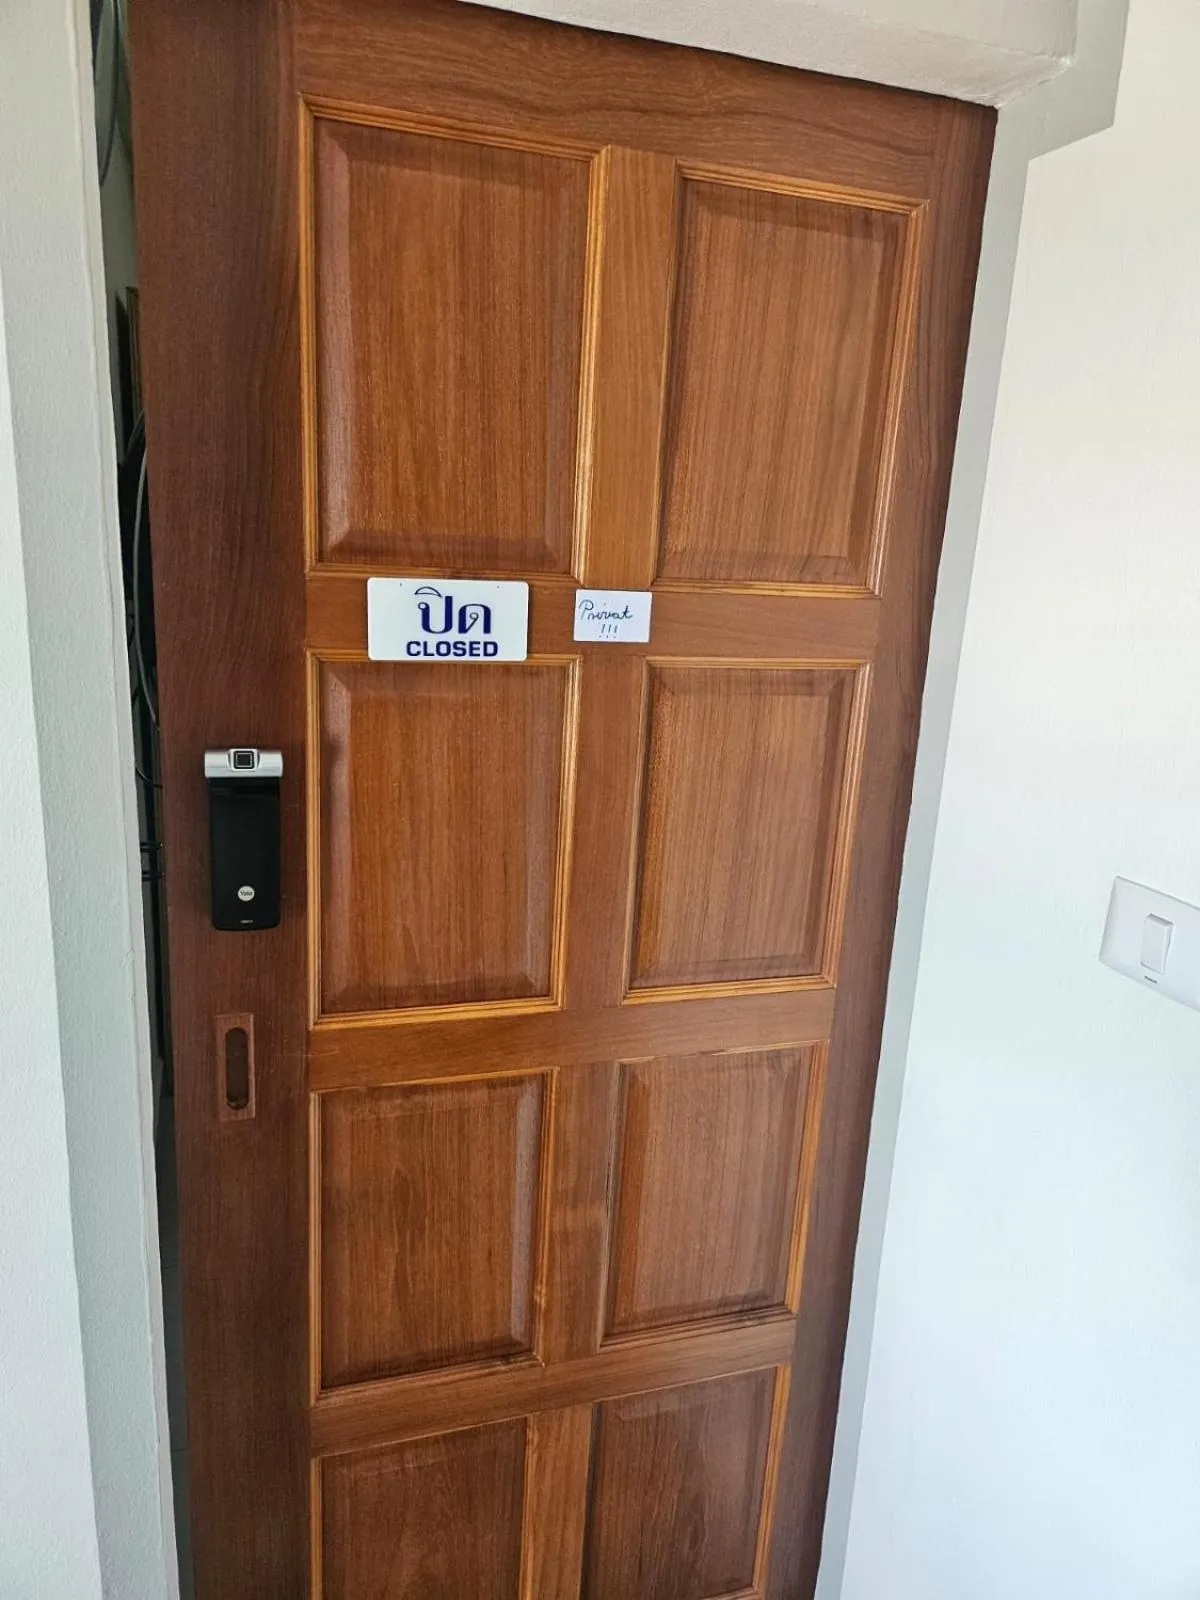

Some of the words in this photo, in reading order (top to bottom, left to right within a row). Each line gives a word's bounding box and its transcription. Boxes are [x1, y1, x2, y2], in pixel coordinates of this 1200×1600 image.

[414, 586, 492, 634] ปิด
[579, 599, 634, 620] Privat
[406, 640, 498, 657] CLOSED
